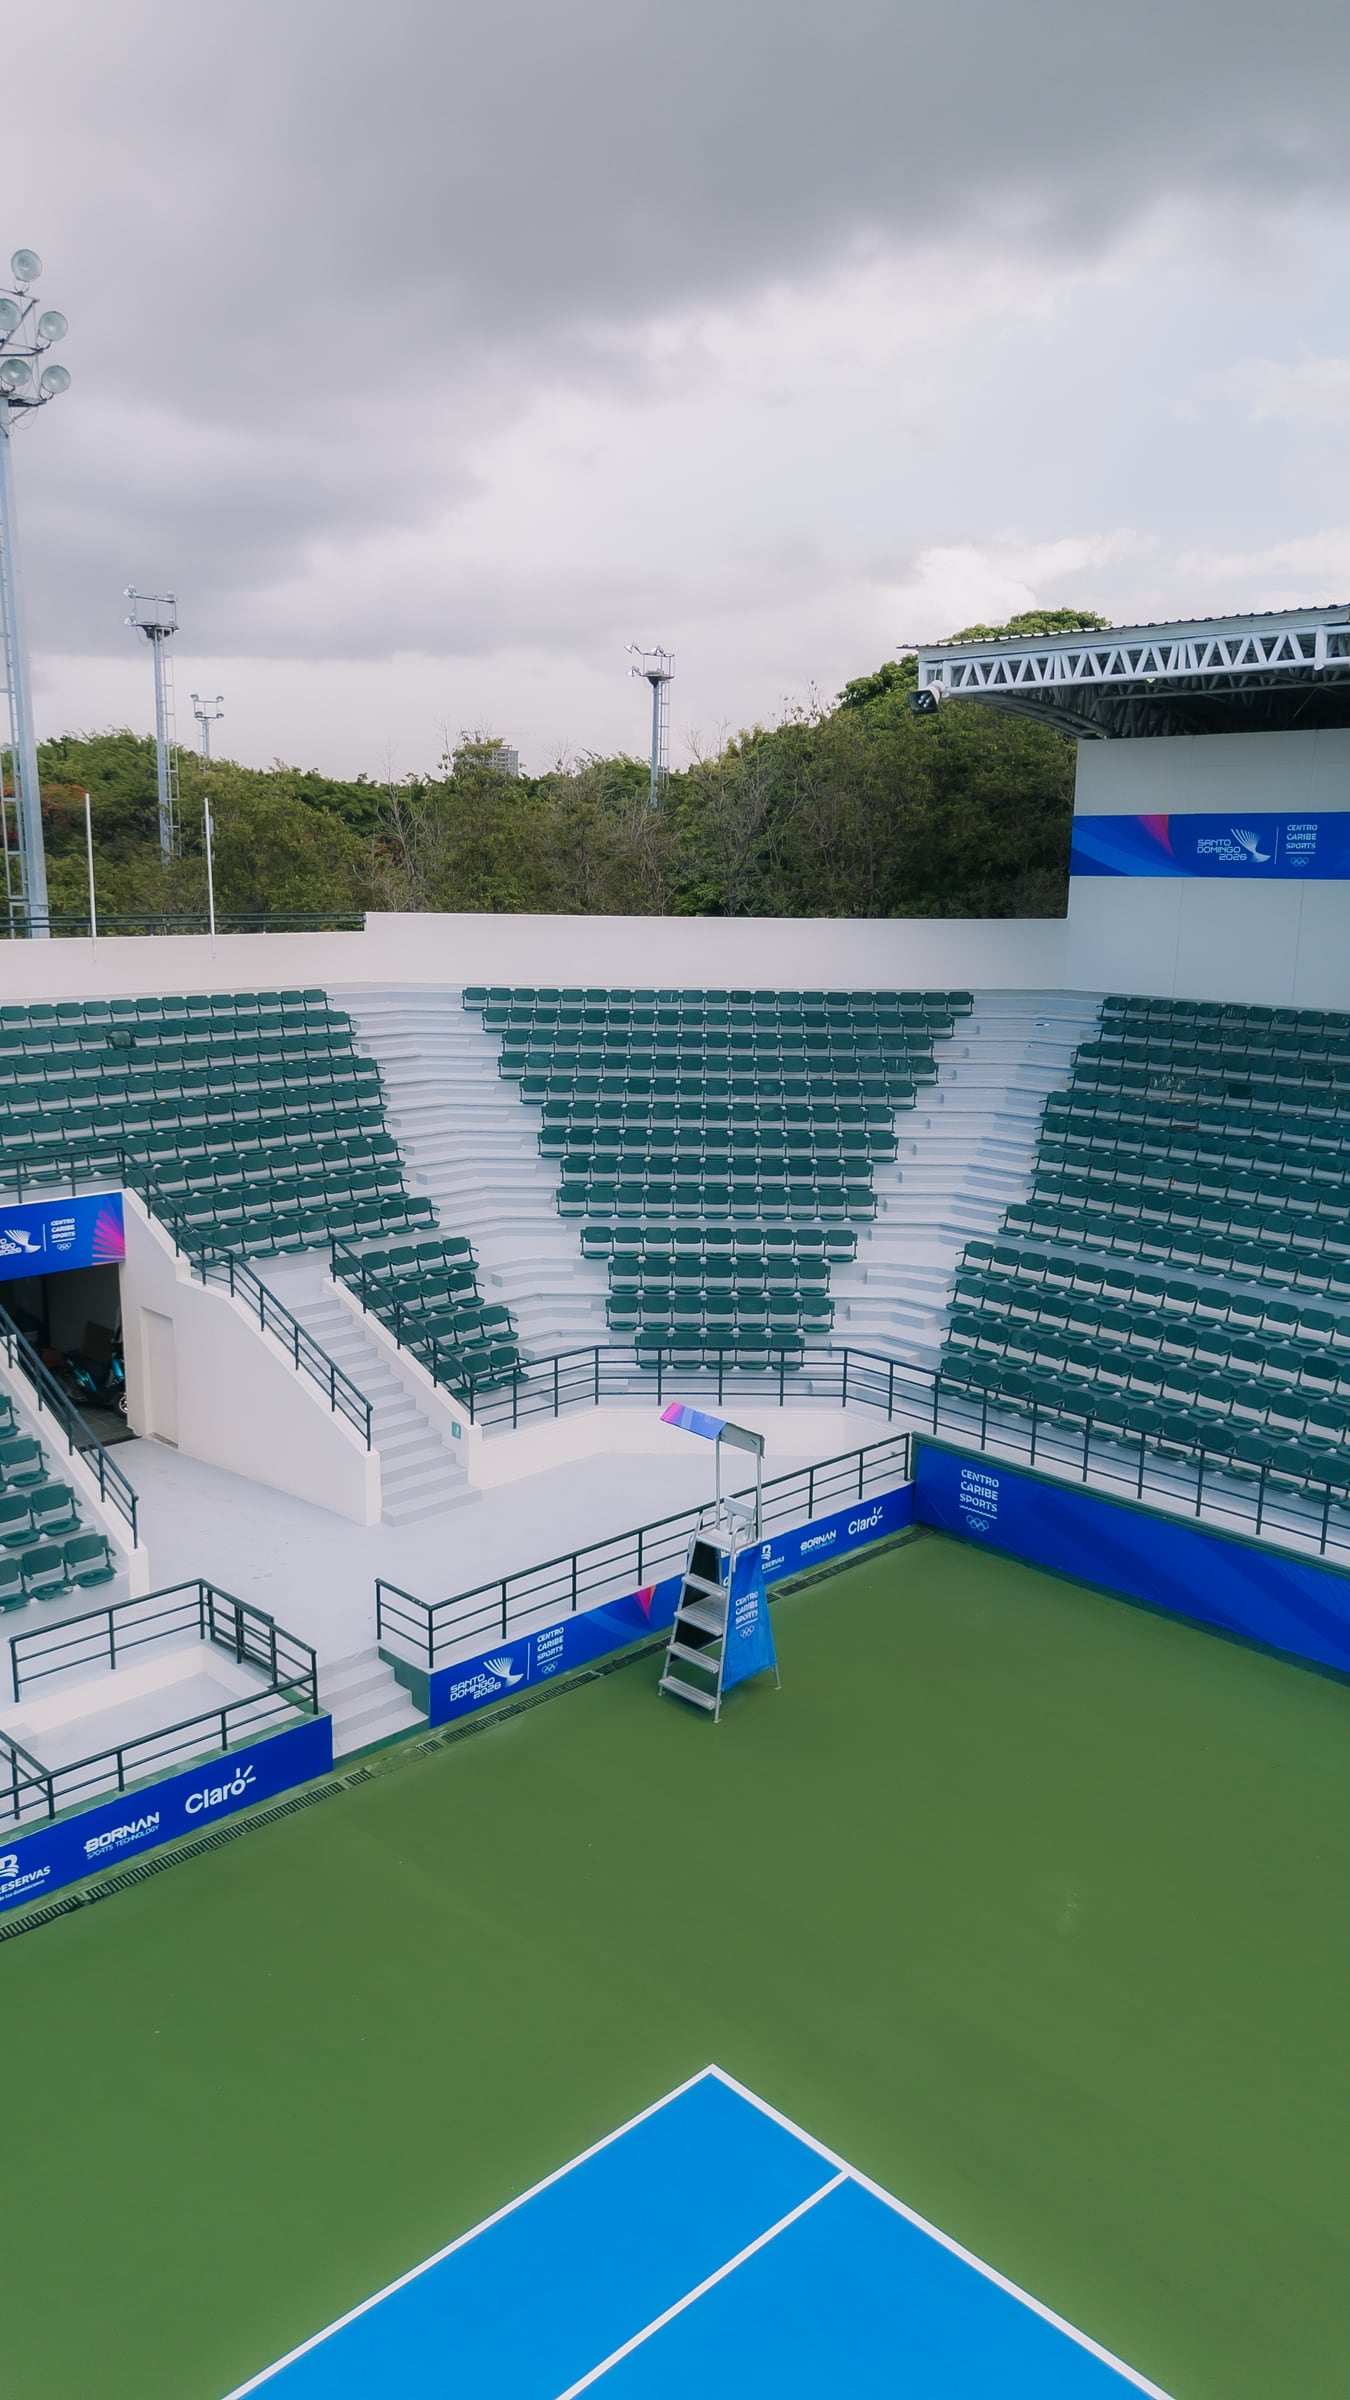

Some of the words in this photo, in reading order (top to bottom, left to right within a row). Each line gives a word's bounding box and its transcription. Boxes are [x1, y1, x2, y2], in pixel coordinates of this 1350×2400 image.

[1287, 824, 1318, 832] CENTRO
[1197, 839, 1231, 847] SANTO
[1286, 833, 1317, 841] CARIBE
[1197, 846, 1241, 854] DOMINGO
[1286, 842, 1316, 850] SPORTS
[1219, 853, 1247, 861] 2026
[961, 1469, 999, 1488] CENTRO
[960, 1481, 999, 1501] CARIBE
[960, 1493, 998, 1512] SPORTS
[847, 1510, 880, 1535] Claro
[800, 1530, 836, 1551] BORNAN
[735, 1591, 758, 1606] CENTRO
[735, 1599, 758, 1615] CARIBE
[735, 1609, 758, 1624] SPORTS
[537, 1626, 564, 1643] CENTRO
[537, 1635, 564, 1652] CARIBE
[537, 1644, 564, 1661] SPORTS
[450, 1673, 486, 1694] SANTO
[450, 1676, 495, 1702] DOMINGO
[473, 1681, 502, 1699] 2026
[185, 1770, 250, 1814] Claro
[83, 1811, 160, 1852] BORNAN
[86, 1843, 114, 1860] SPORTS
[115, 1823, 160, 1848] TECHNOLOGY
[0, 1865, 51, 1894] ESERVAS
